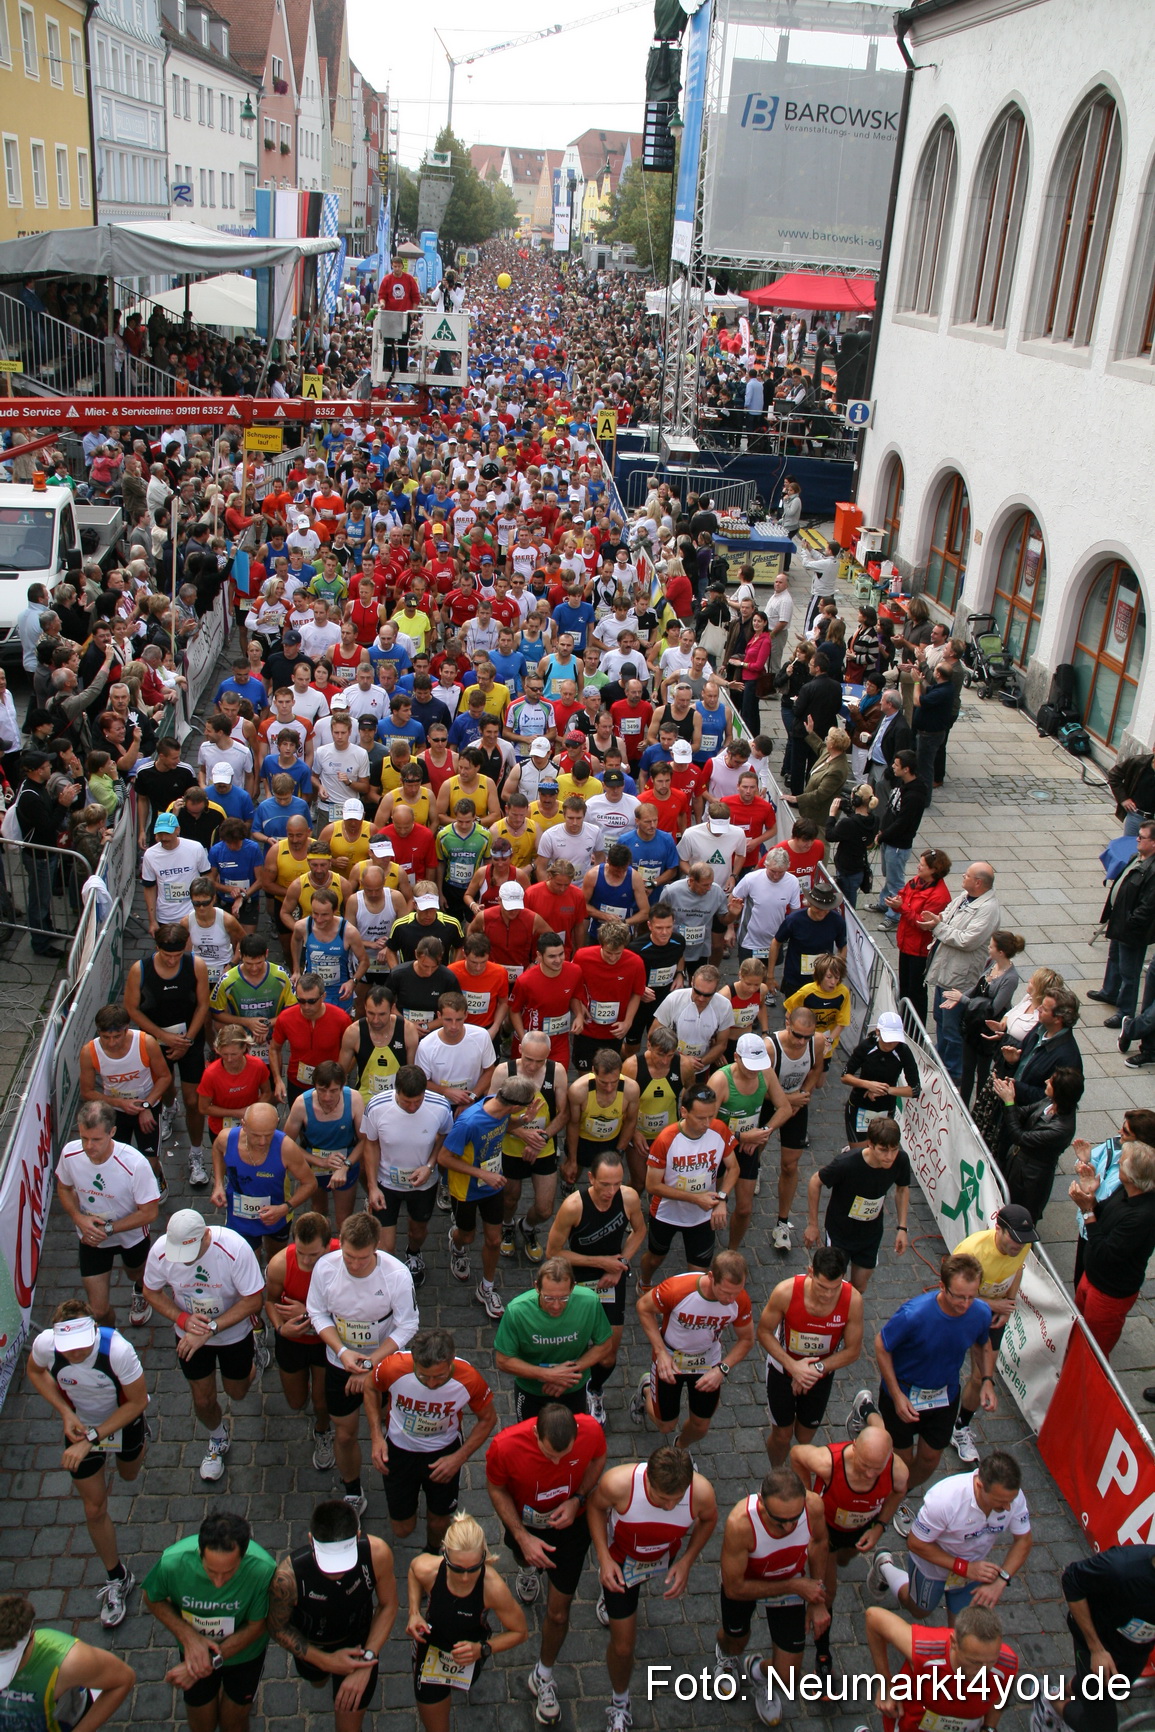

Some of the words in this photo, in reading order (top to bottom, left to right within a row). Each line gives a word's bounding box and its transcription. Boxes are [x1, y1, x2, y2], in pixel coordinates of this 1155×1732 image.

[785, 123, 850, 137] Veranstaltungs-
[853, 130, 870, 139] und
[306, 384, 318, 398] A
[22, 407, 61, 417] Service
[85, 407, 109, 417] Miet-
[121, 406, 174, 417] Serviceline:
[176, 406, 200, 416] 09181
[202, 405, 224, 416] 6352
[316, 407, 335, 416] 6352
[601, 419, 613, 433] A
[247, 431, 281, 441] Schnupper-
[159, 867, 183, 877] PETER
[456, 870, 472, 878] 2030
[467, 1000, 487, 1008] 2207
[741, 1015, 755, 1023] 692
[672, 1149, 717, 1166] MERZ
[244, 1203, 266, 1212] 390
[678, 1312, 732, 1328] MERZ
[833, 1315, 841, 1323] LG
[346, 1322, 370, 1330] Matthias
[351, 1331, 372, 1340] 110
[531, 1331, 578, 1346] Sinupret
[803, 1341, 824, 1351] 938
[687, 1357, 706, 1366] 548
[397, 1393, 457, 1413] MERZ
[181, 1595, 240, 1611] Sinupret
[194, 1617, 221, 1626] Michael
[442, 1663, 465, 1675] 602
